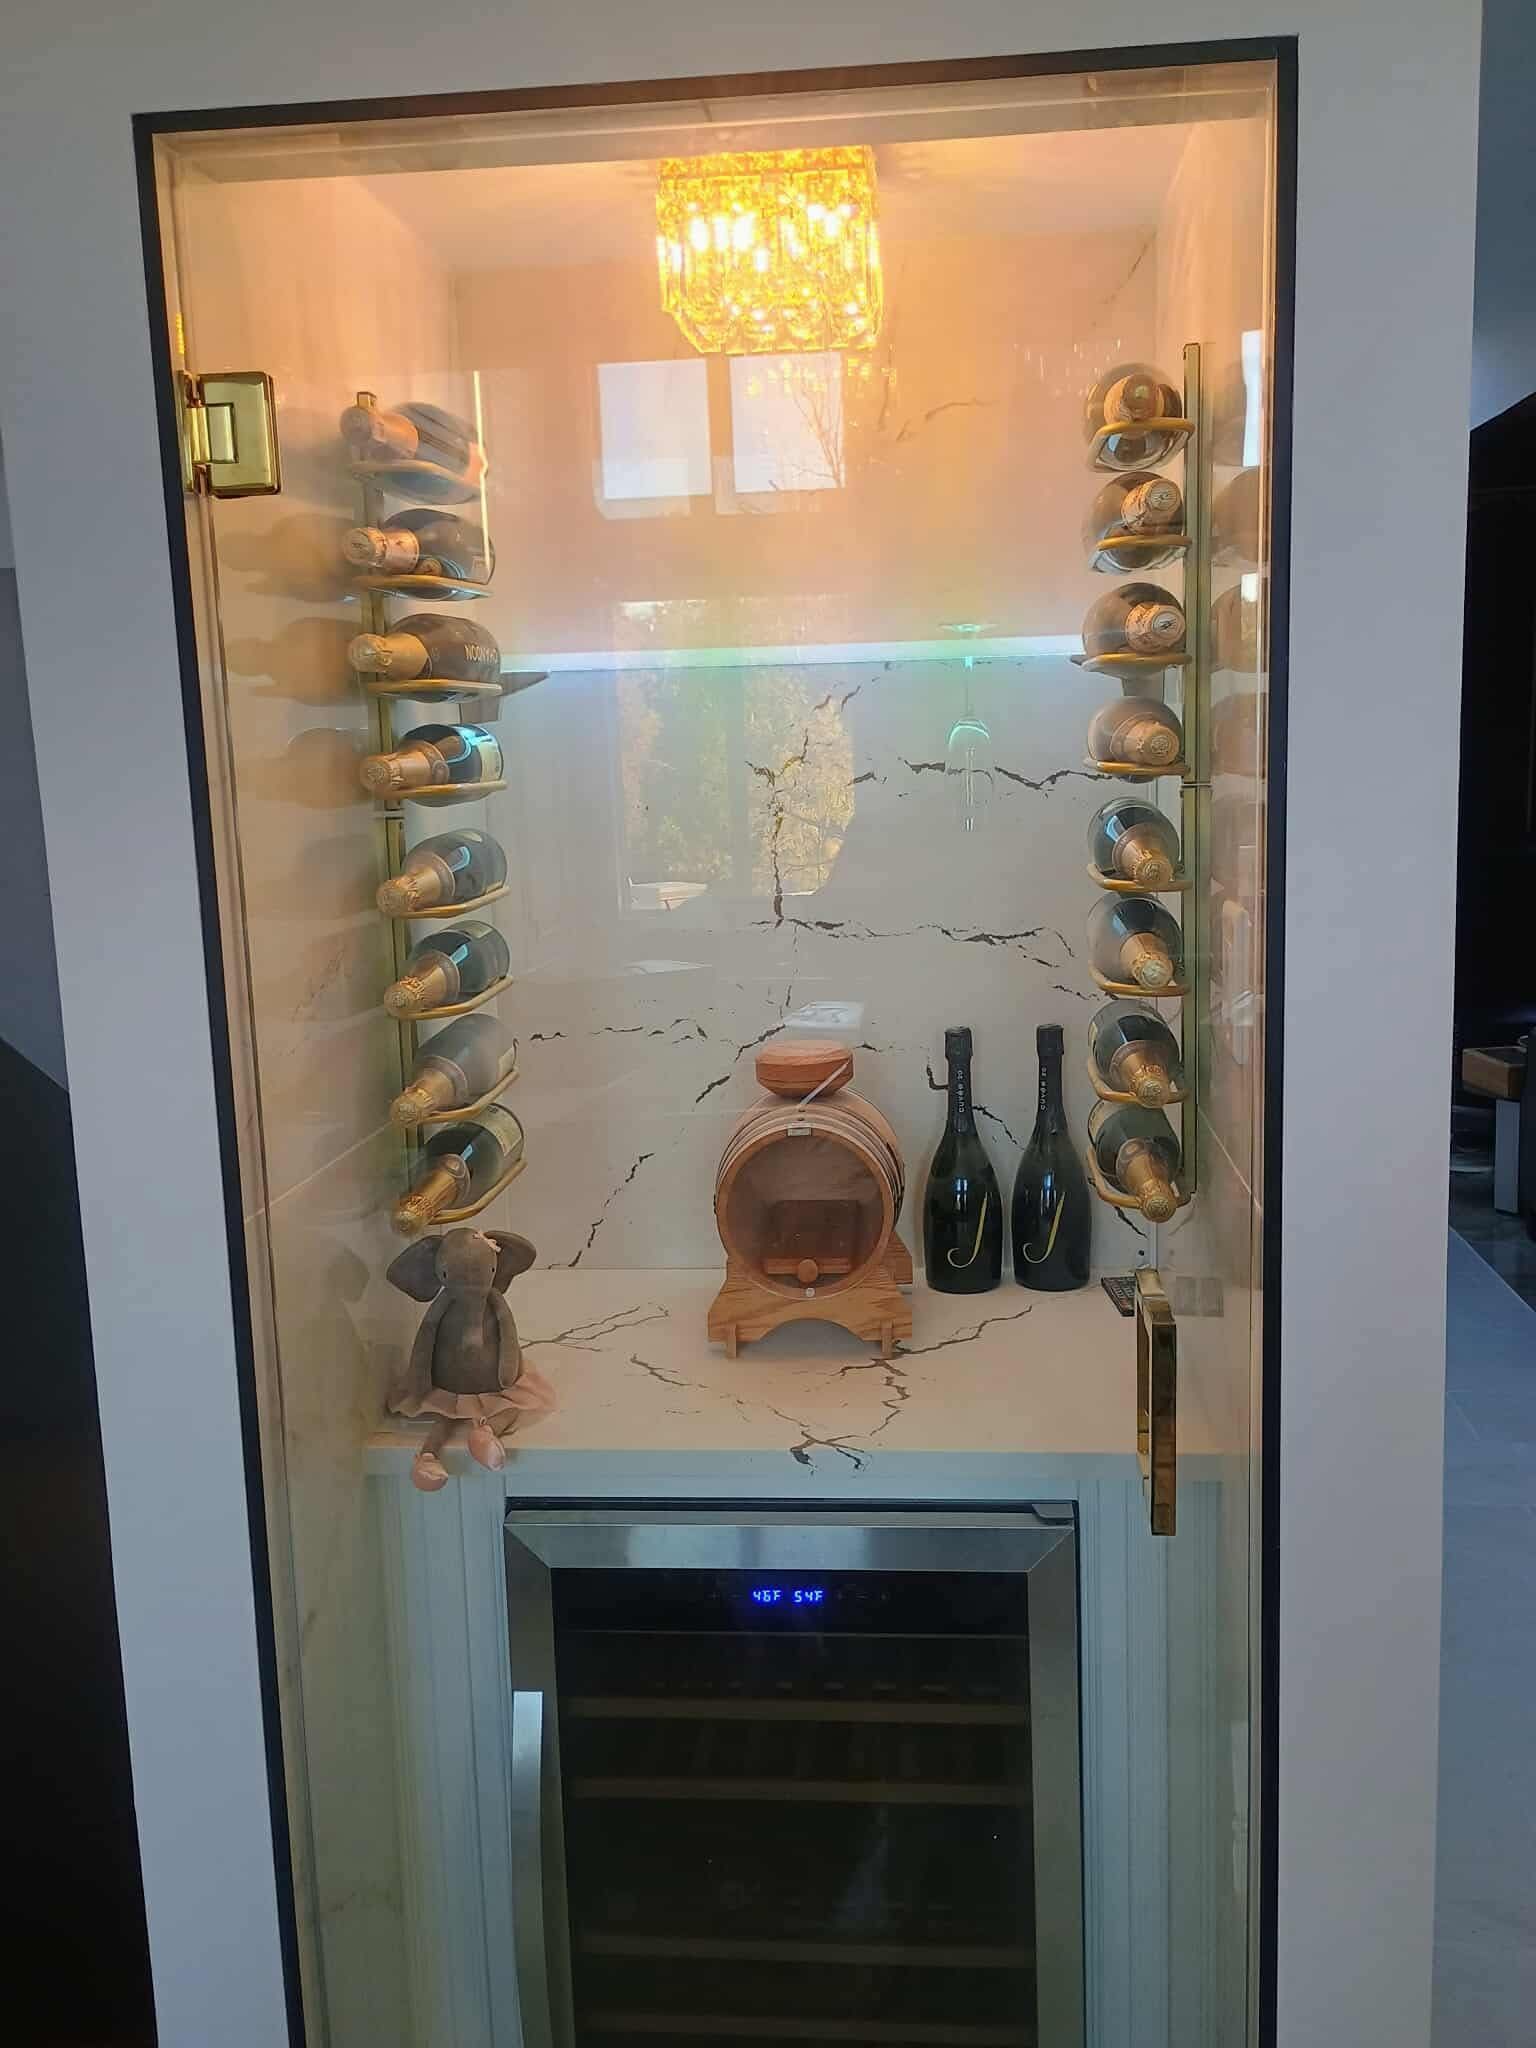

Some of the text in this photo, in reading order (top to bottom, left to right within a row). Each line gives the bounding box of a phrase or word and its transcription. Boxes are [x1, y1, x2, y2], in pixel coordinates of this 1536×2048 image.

[947, 1192, 988, 1268] J
[1023, 1192, 1066, 1264] J
[753, 1590, 824, 1603] 46F 54F
